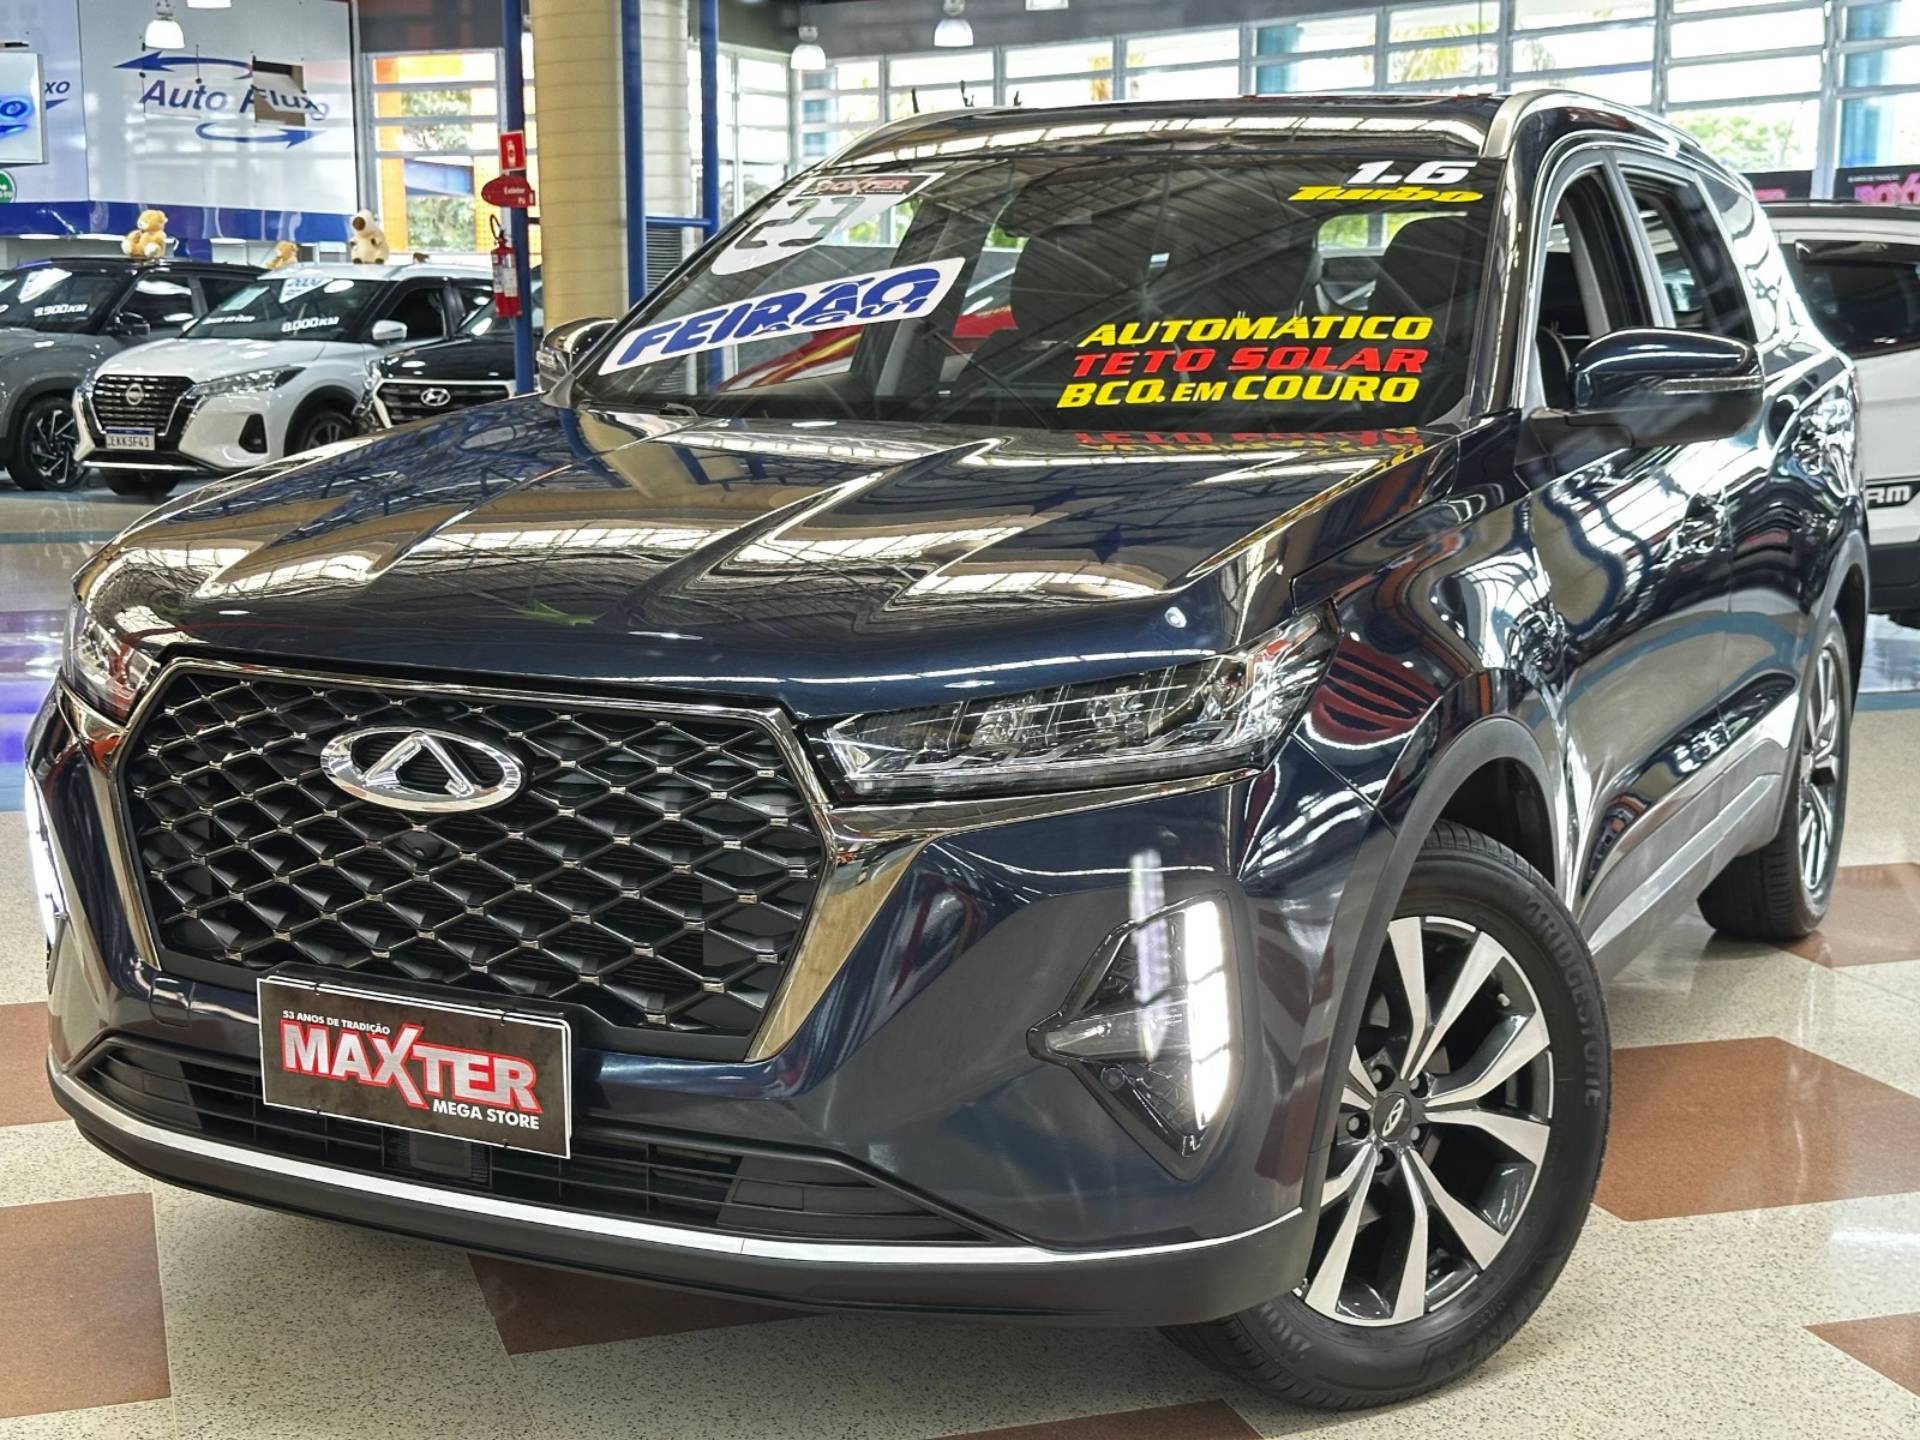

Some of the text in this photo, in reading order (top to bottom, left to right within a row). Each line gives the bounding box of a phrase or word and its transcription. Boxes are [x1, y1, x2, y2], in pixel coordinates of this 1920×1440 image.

[138, 79, 229, 111] Auto
[1347, 160, 1478, 184] 1.6
[1288, 186, 1484, 203] Turbo
[616, 268, 941, 366] FEIRÃO
[1073, 346, 1429, 378] TETO SOLAR
[1171, 382, 1228, 402] EM
[1232, 375, 1421, 403] COURO
[282, 1010, 391, 1035] 53 ANOS DE TRADIÇÃO
[281, 1020, 543, 1113] MAXTER
[432, 1098, 540, 1130] MEGA STORE
